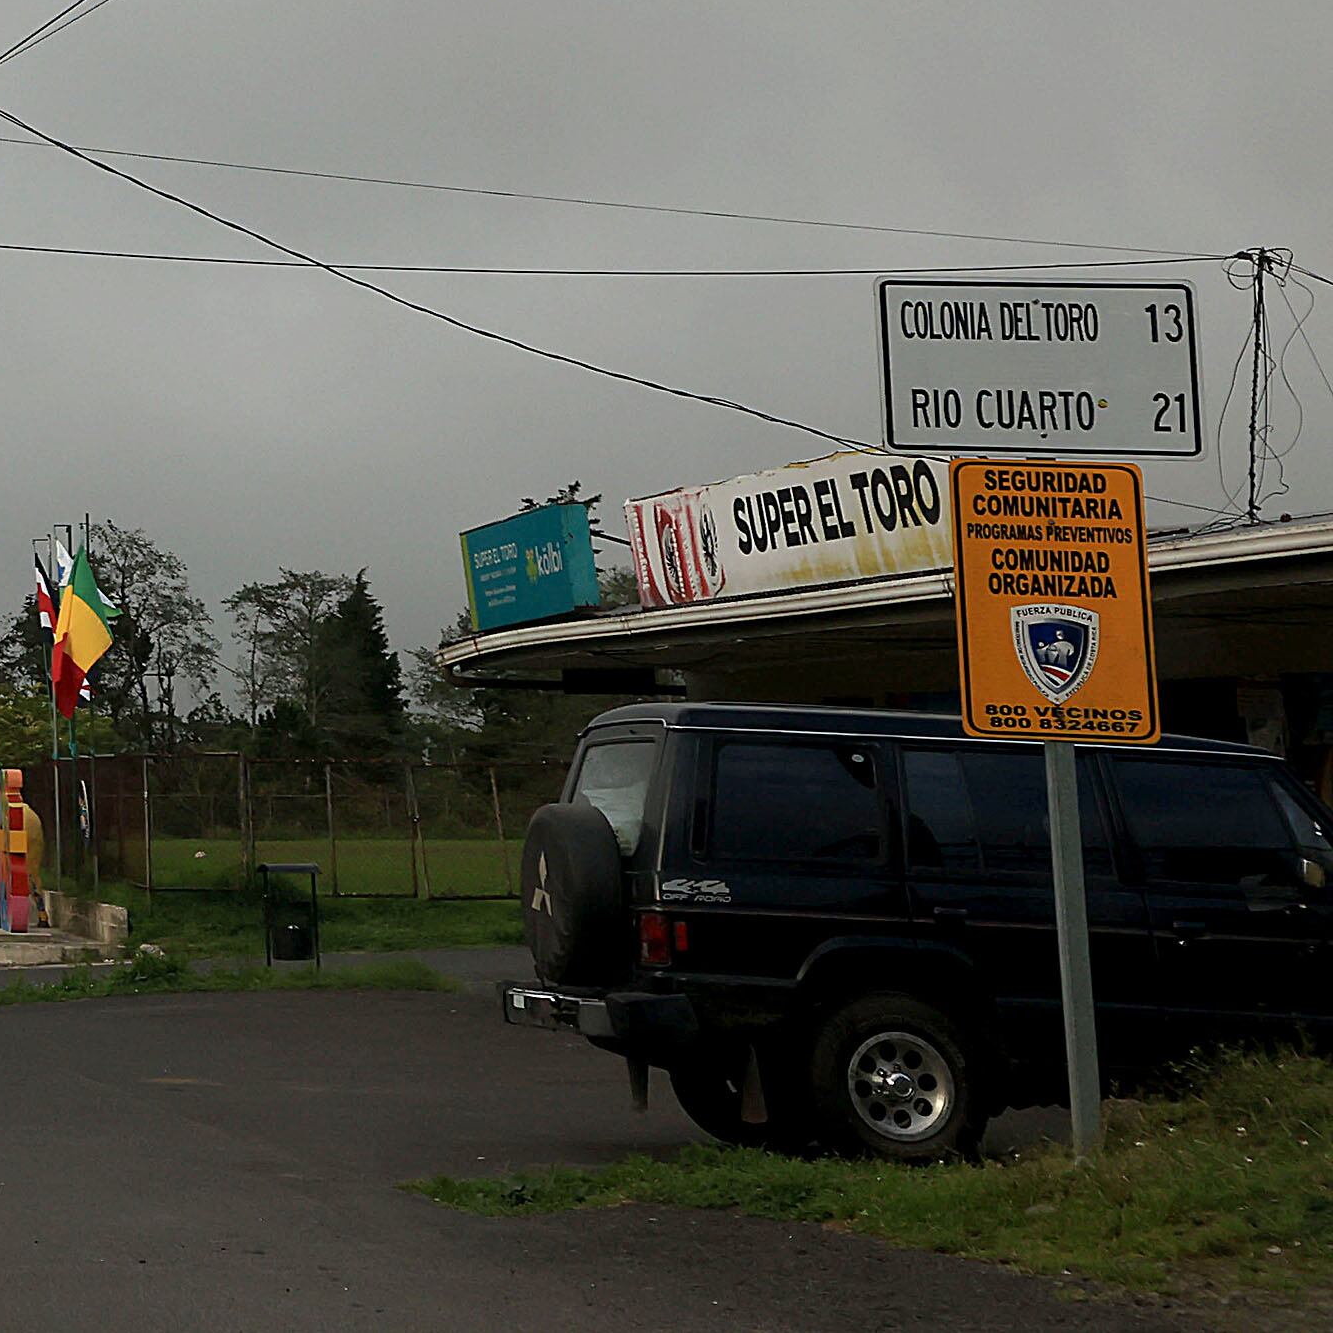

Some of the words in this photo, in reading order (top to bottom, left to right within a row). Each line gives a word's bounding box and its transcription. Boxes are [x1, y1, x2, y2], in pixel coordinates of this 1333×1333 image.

[900, 301, 992, 340] COLONIA
[1000, 303, 1039, 341] DEL
[1041, 303, 1099, 343] TORO
[1145, 304, 1183, 343] 13
[912, 388, 961, 428] RIO
[977, 390, 1094, 431] CUARTO
[1153, 393, 1186, 433] 21
[984, 470, 1106, 494] SEGURIDAD
[733, 486, 815, 555] SUPER
[815, 478, 856, 541] EL
[850, 459, 941, 533] TORO
[972, 495, 1122, 520] COMUNITARIA
[967, 523, 1043, 542] PROGRAMAS
[1046, 525, 1133, 545] PREVENTIVOS
[474, 548, 492, 568] SUPER
[991, 551, 1110, 573] COMUNIDAD
[989, 574, 1117, 599] ORGANIZADA
[1017, 607, 1051, 618] FUERZA
[1055, 607, 1093, 621] PUBLICA
[985, 704, 1027, 716] 800
[1034, 706, 1143, 721] VECINOS
[989, 717, 1032, 729] 800
[1039, 719, 1139, 733] 8324667
[662, 893, 689, 901] OFF
[694, 894, 732, 903] ROAD
